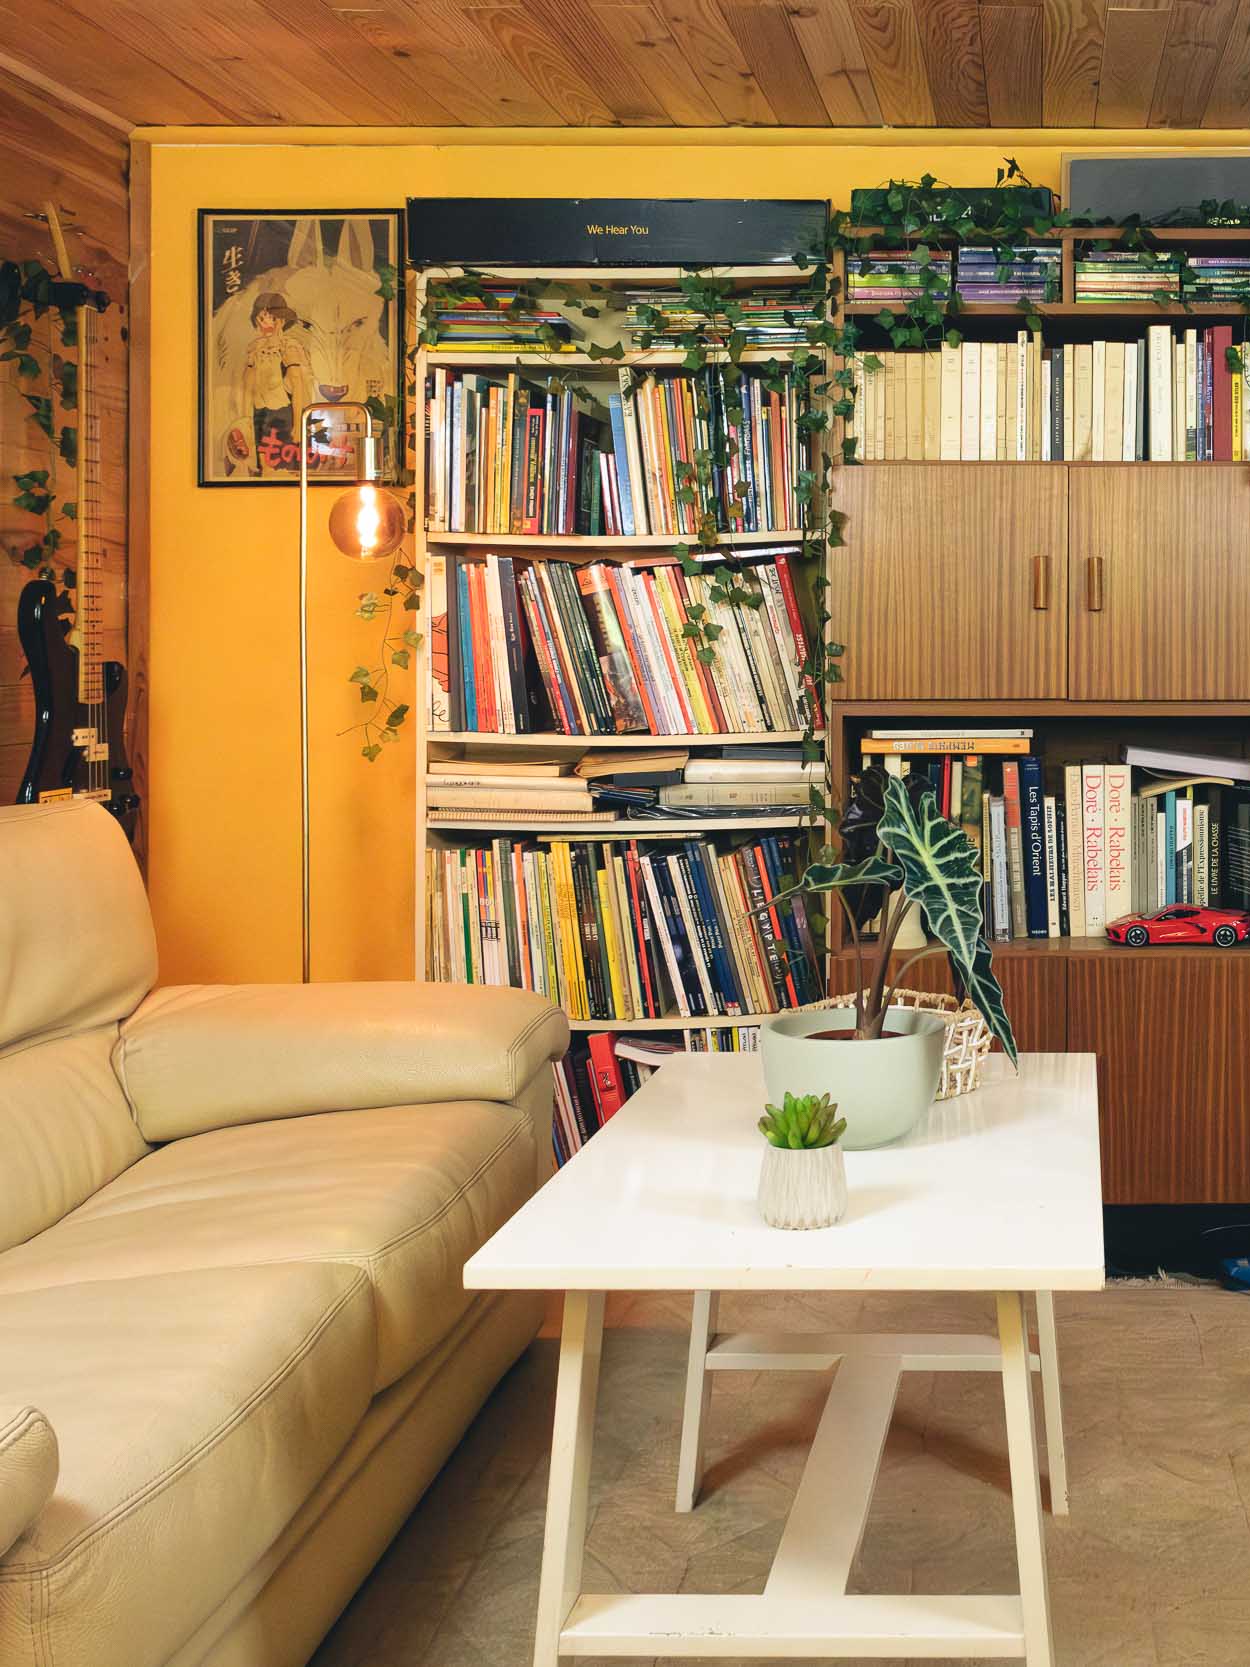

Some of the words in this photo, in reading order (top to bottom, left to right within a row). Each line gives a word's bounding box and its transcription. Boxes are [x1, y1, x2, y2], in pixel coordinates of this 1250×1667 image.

[586, 224, 604, 236] We
[605, 224, 628, 236] Hear
[630, 224, 649, 236] You
[1029, 786, 1040, 803] Les
[1029, 805, 1041, 832] Tapis
[1211, 823, 1219, 847] CHASSE
[1030, 833, 1042, 877] d'Orient
[1086, 827, 1104, 893] Rabelais
[1108, 827, 1127, 893] Rabelais
[1211, 847, 1219, 857] LA
[1211, 857, 1219, 867] DE
[1211, 868, 1219, 886] LIVRE
[1211, 887, 1219, 895] LE
